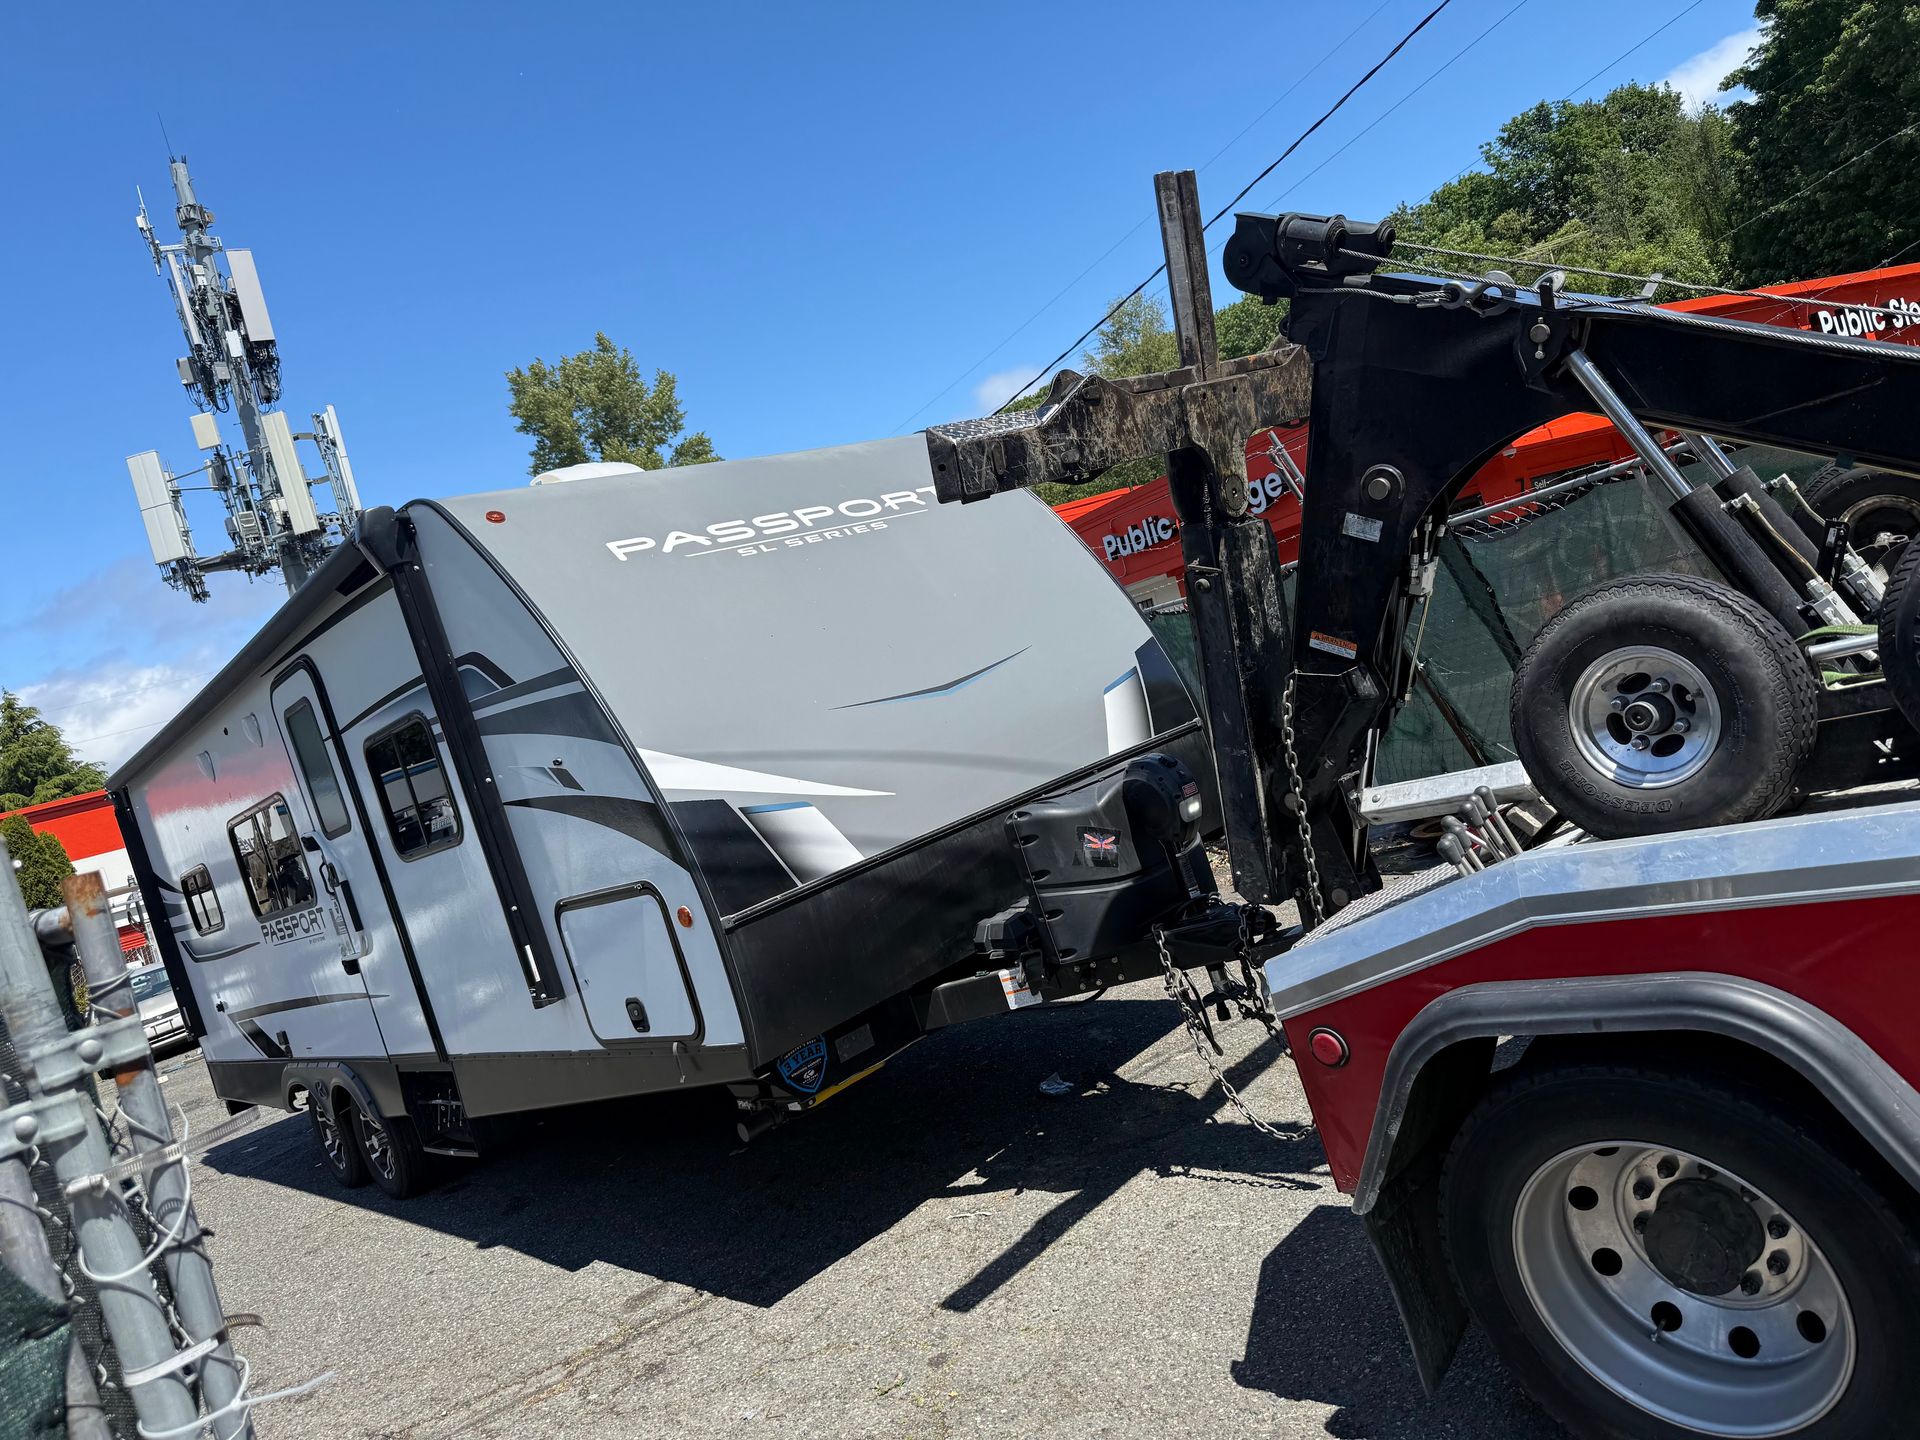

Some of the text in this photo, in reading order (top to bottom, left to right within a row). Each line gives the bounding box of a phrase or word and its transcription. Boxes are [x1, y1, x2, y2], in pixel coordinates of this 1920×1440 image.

[1818, 303, 1886, 337] Public
[737, 520, 889, 557] SL SERIES
[1102, 516, 1173, 562] Public
[261, 907, 326, 944] PASSPORT
